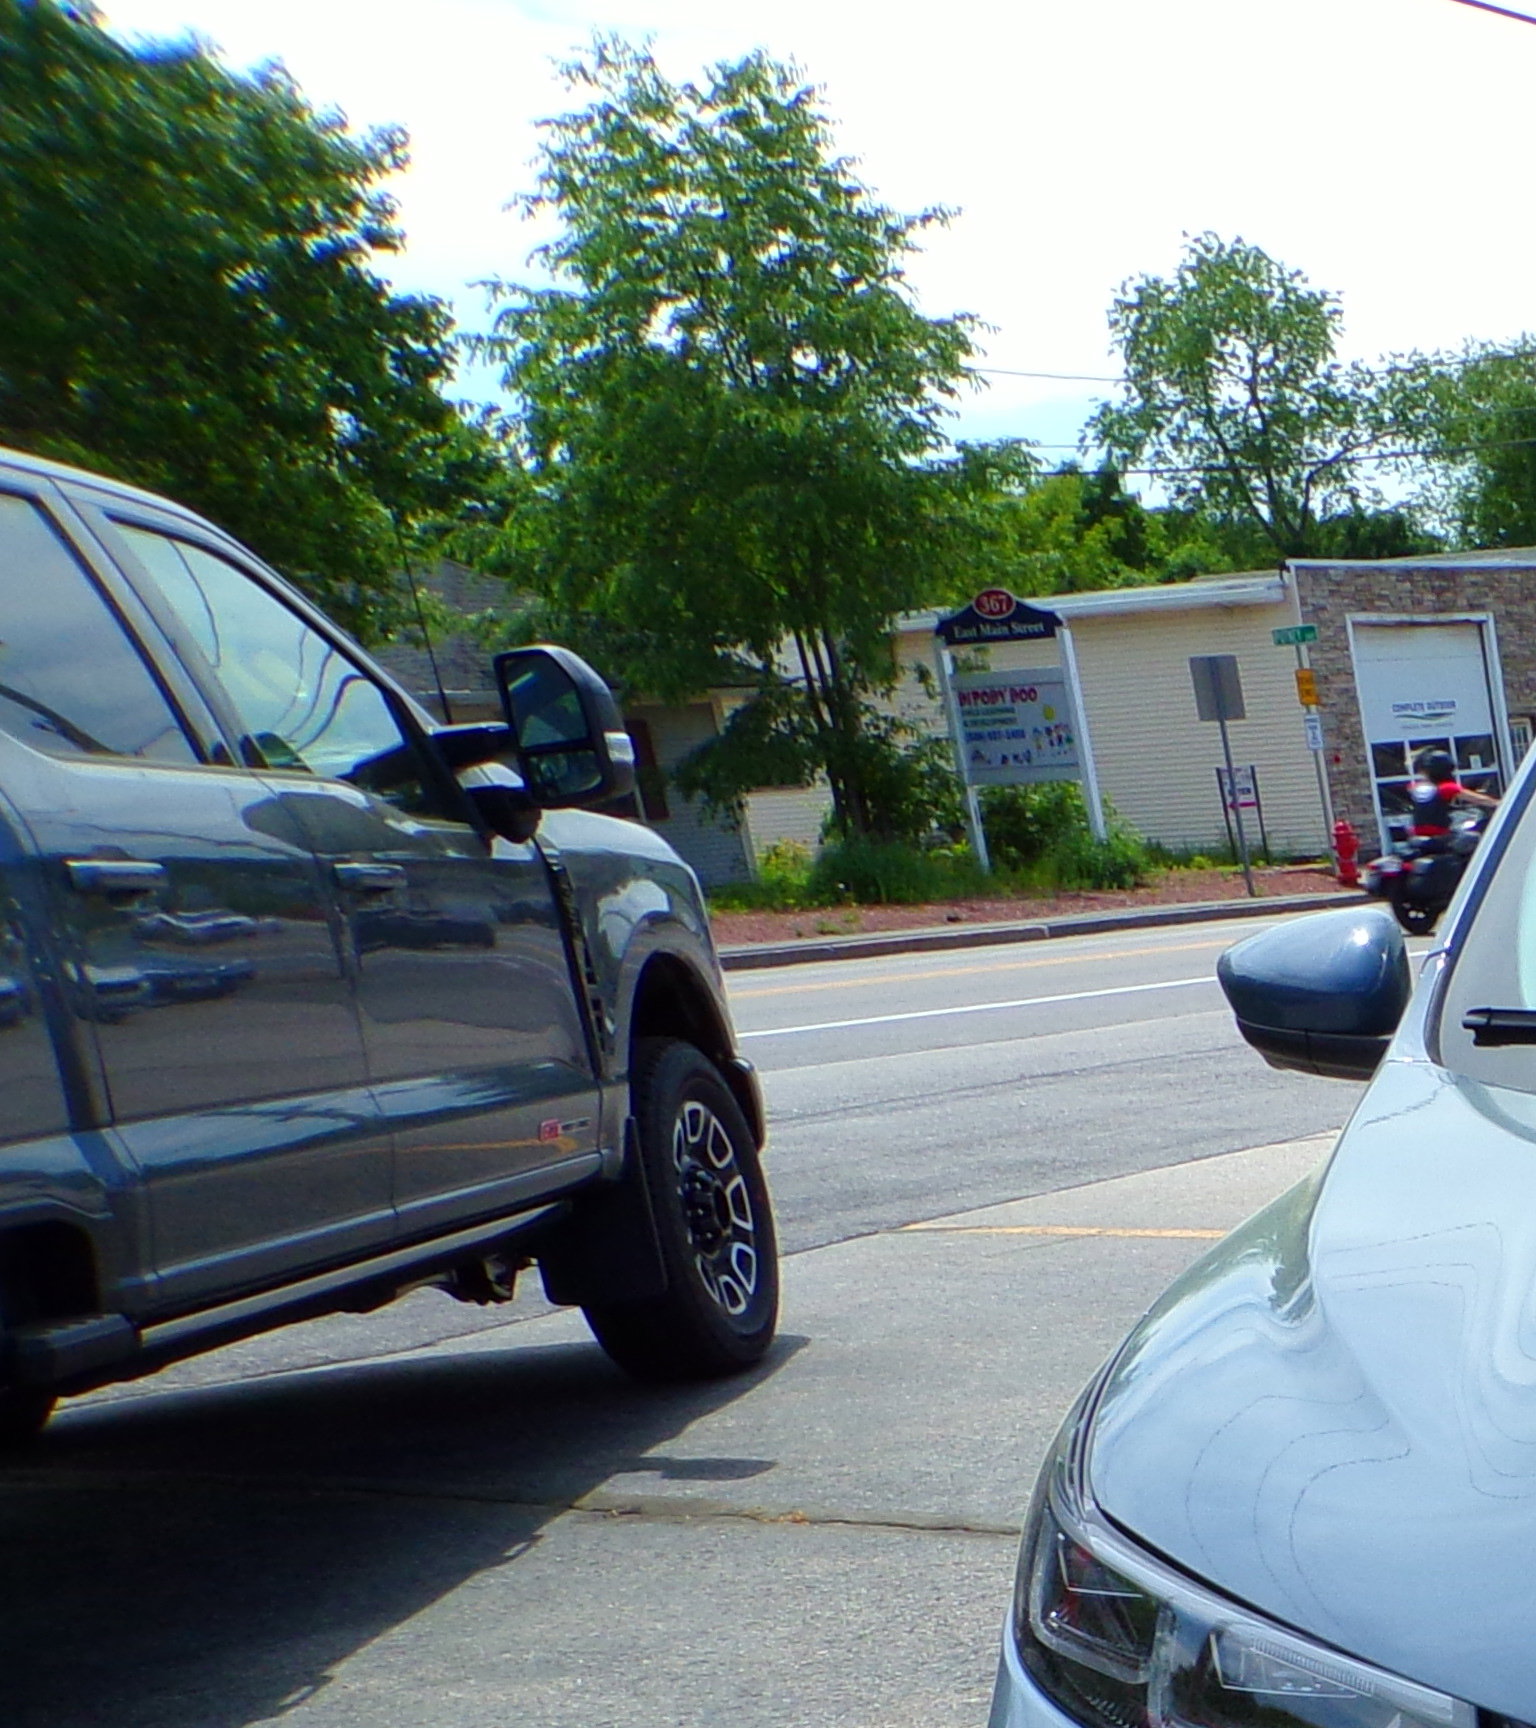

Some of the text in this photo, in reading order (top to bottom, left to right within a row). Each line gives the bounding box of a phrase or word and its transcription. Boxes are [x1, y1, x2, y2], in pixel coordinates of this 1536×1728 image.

[980, 594, 1008, 613] 367
[953, 621, 1045, 639] East Main Street
